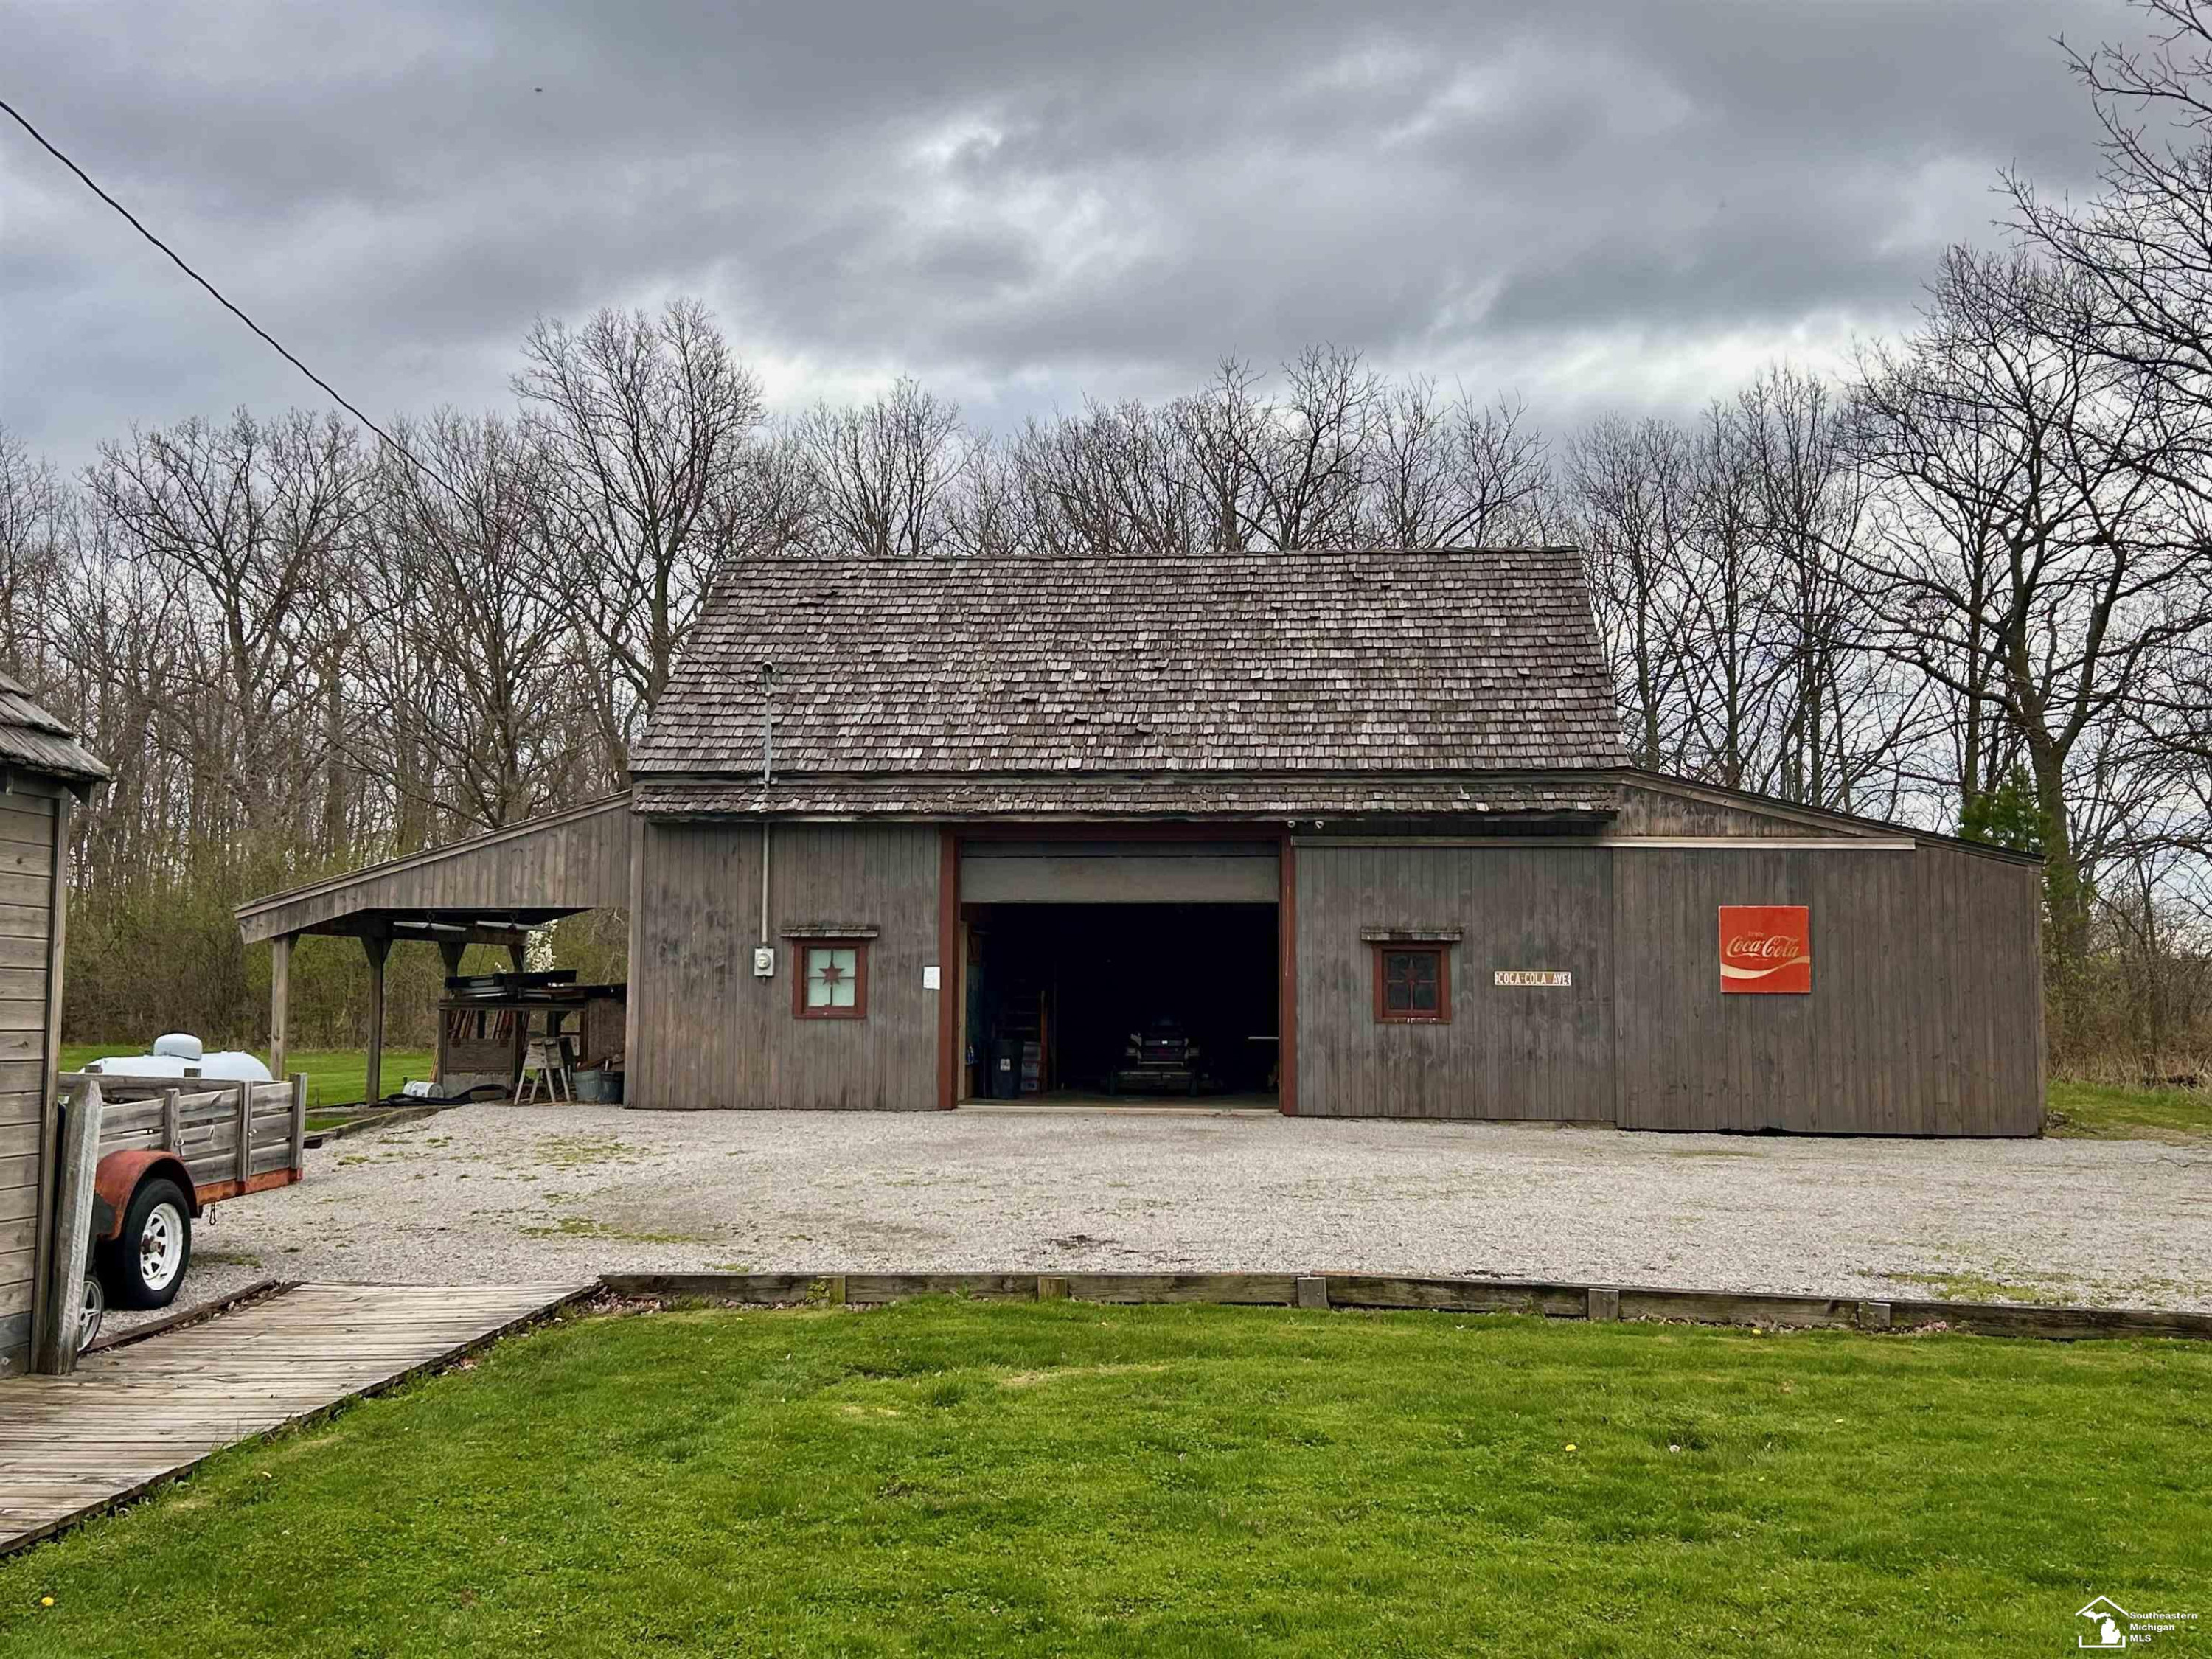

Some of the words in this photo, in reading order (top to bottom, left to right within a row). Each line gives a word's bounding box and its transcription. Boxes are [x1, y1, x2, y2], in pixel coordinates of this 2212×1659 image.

[1726, 935, 1800, 958] Coca-Cola
[1498, 973, 1547, 984] COCA-COLA
[1552, 973, 1568, 985] AVE
